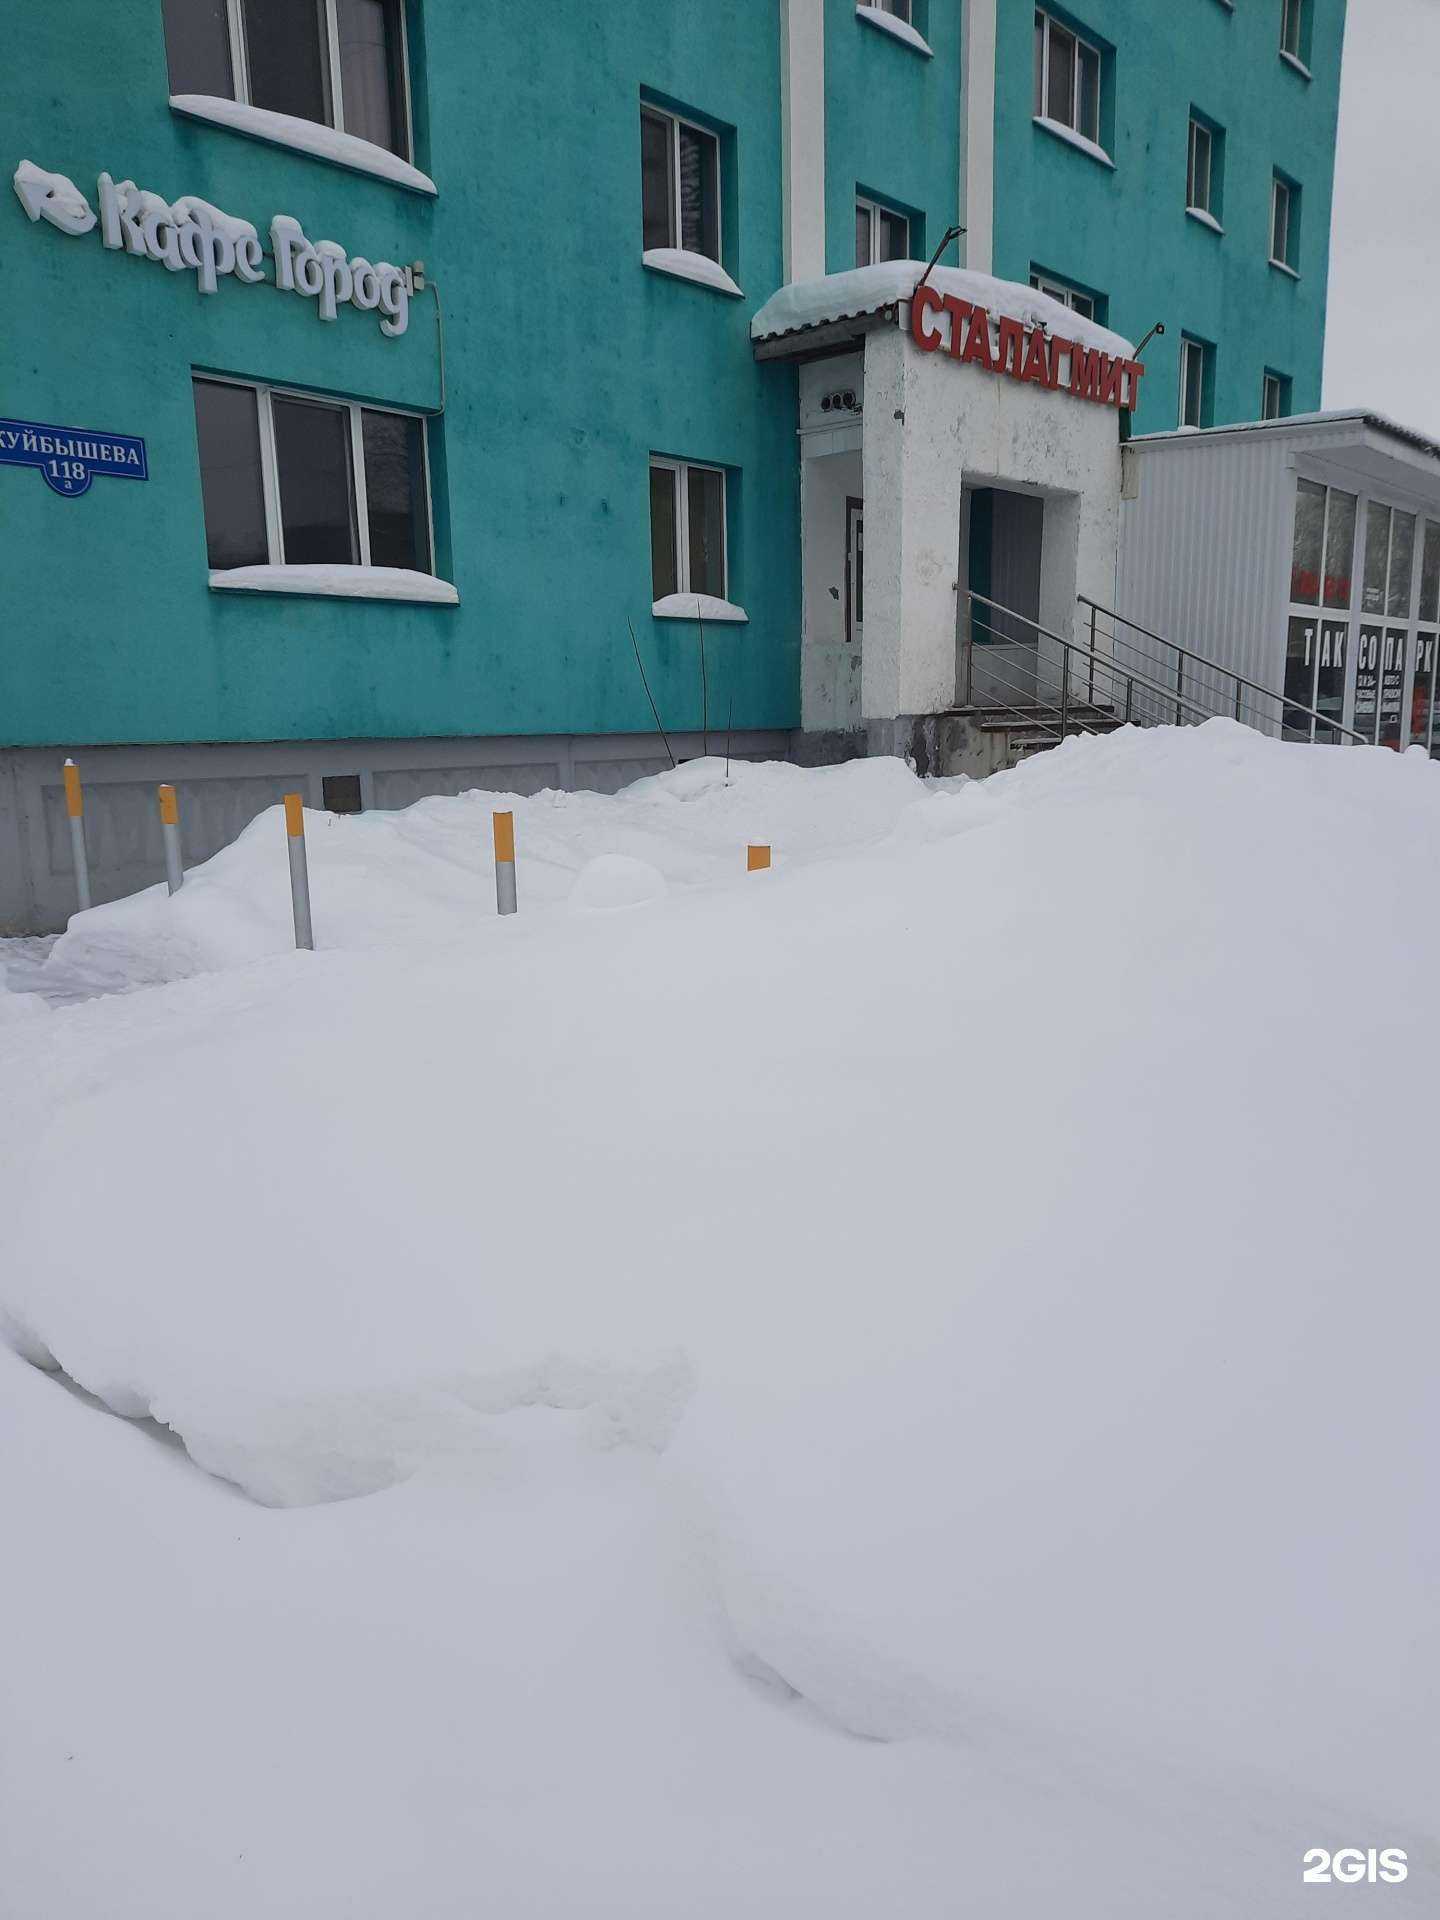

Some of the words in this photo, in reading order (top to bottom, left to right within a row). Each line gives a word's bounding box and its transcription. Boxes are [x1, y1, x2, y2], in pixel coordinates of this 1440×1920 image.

[98, 178, 266, 293] Кафе
[270, 220, 410, 337] Город
[911, 286, 1144, 412] СТАЛАГМИТ
[49, 460, 85, 480] 118
[64, 480, 73, 490] а
